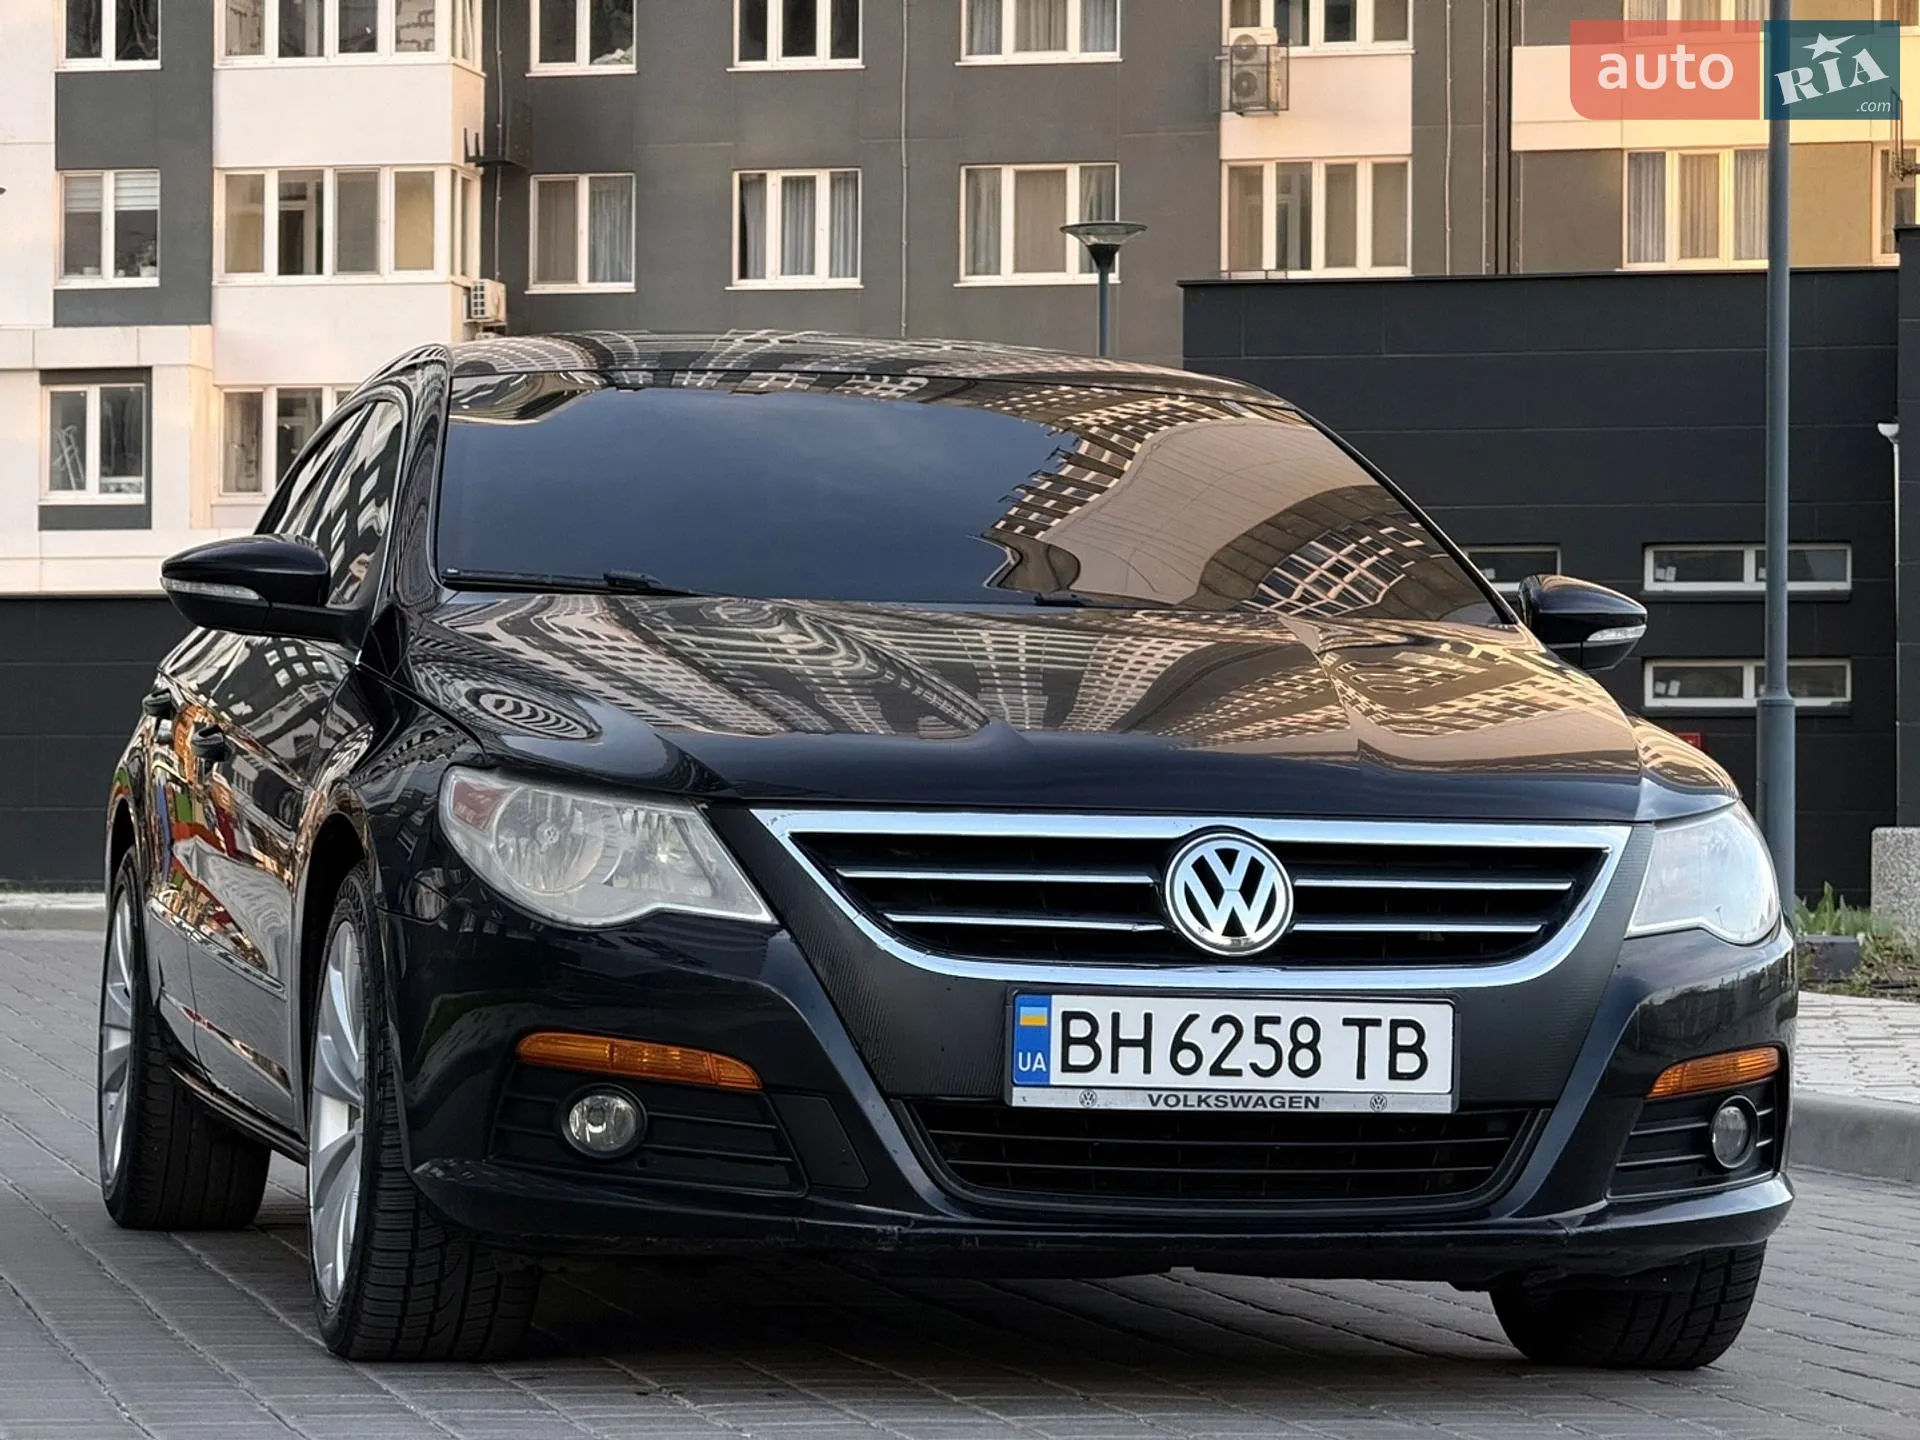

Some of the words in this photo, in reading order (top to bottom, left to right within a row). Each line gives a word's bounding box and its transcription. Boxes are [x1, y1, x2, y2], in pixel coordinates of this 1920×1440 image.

[1060, 1010, 1153, 1074] BH
[1169, 1013, 1322, 1079] 6258
[1341, 1017, 1429, 1081] TB
[1018, 1051, 1047, 1072] UA
[1147, 1093, 1320, 1109] VOLKSWAGEN
